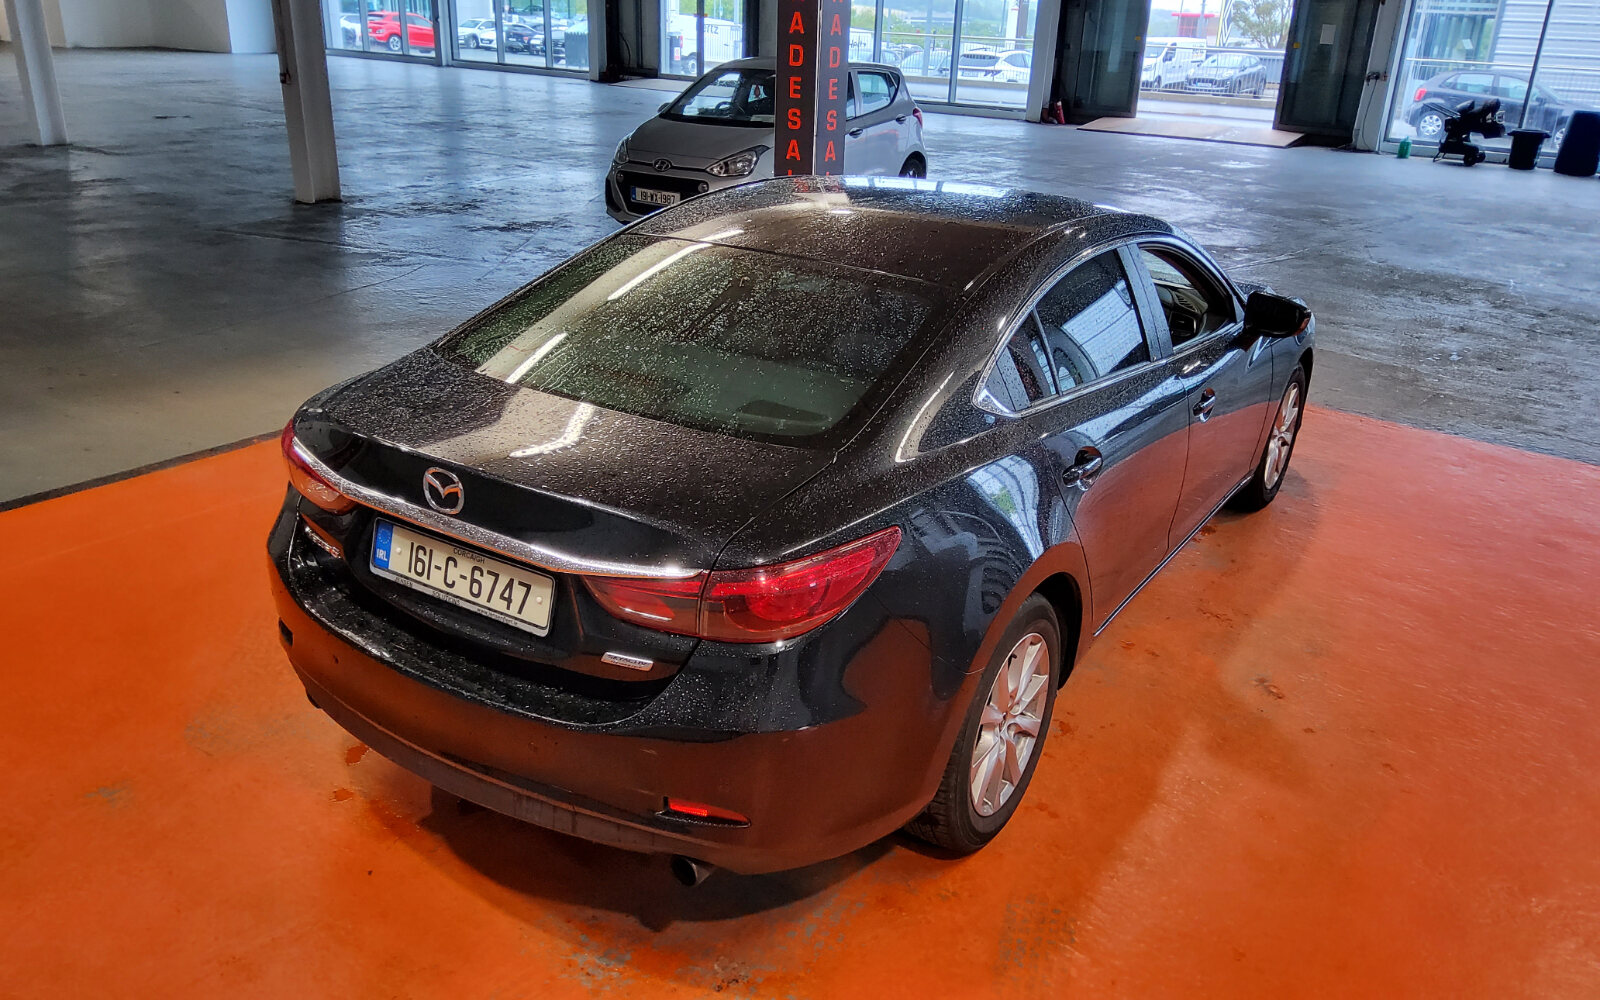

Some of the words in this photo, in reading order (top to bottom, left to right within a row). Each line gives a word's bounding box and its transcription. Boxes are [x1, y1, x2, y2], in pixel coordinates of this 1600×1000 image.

[786, 0, 805, 176] ADESA
[824, 0, 843, 176] ADESA
[376, 548, 388, 562] IRL
[408, 541, 532, 615] 161-C-6747
